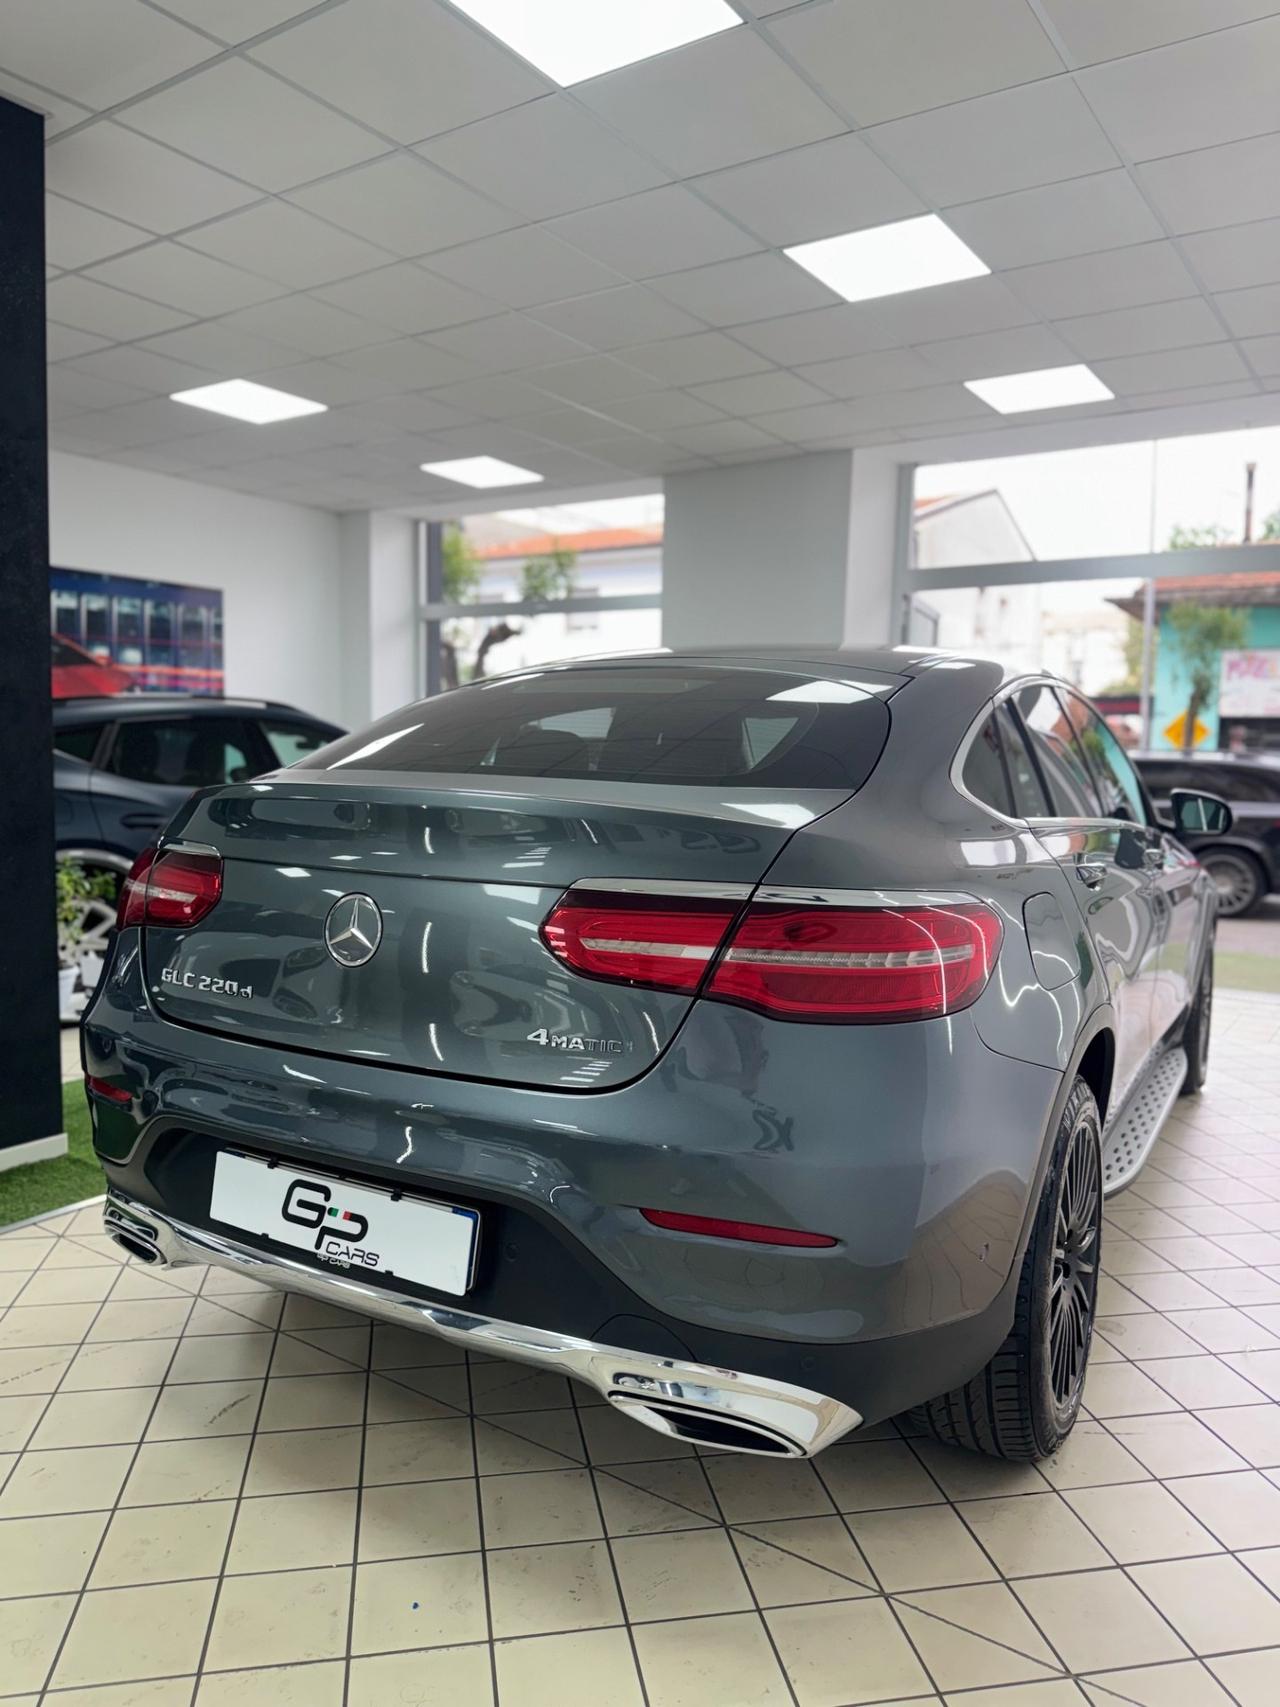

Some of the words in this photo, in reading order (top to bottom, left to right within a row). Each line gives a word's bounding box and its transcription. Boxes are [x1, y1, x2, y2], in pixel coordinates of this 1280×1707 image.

[161, 968, 196, 988] GLC
[526, 1028, 622, 1053] 4MATIC
[325, 1241, 380, 1267] CARS
